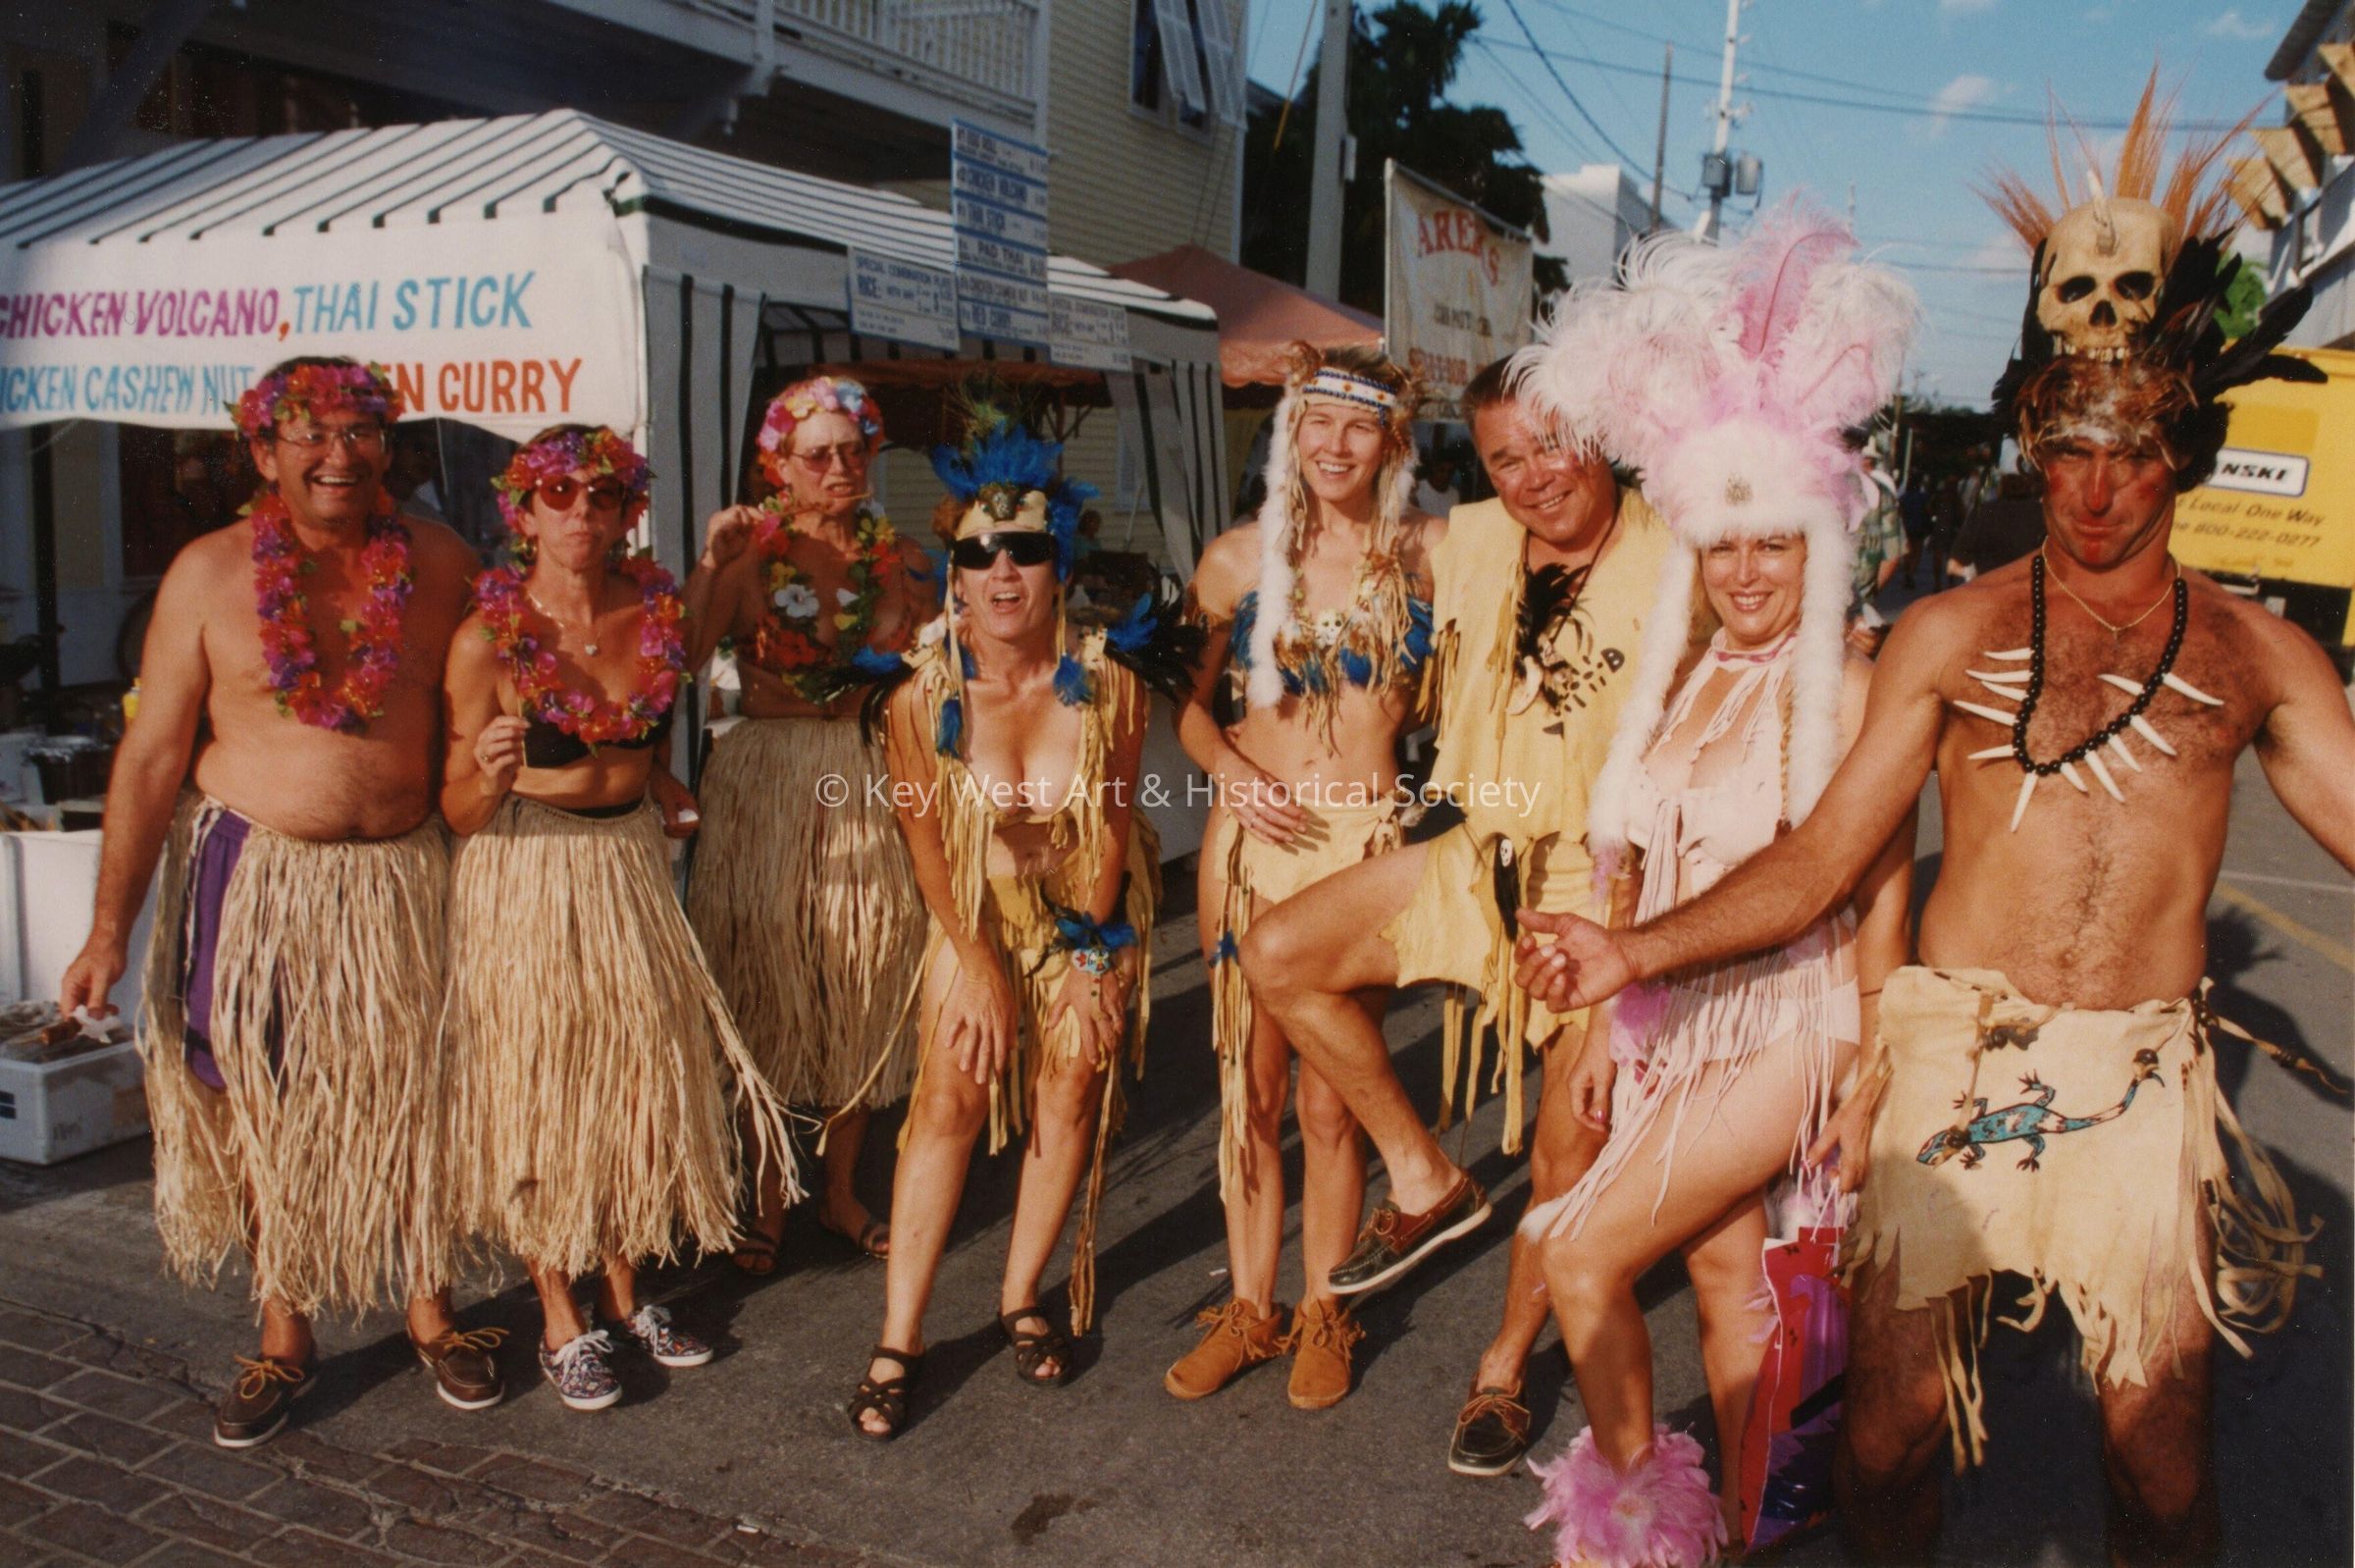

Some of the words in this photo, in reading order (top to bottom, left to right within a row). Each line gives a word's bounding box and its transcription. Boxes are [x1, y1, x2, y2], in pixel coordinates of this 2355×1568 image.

[292, 279, 377, 334] THAI
[392, 271, 536, 331] STICK
[0, 365, 76, 413] ICKEN
[85, 365, 194, 415] CASHEW
[439, 358, 582, 413] CURRY
[2188, 497, 2240, 513] Local
[2246, 503, 2281, 519] One
[2287, 508, 2326, 526] Way
